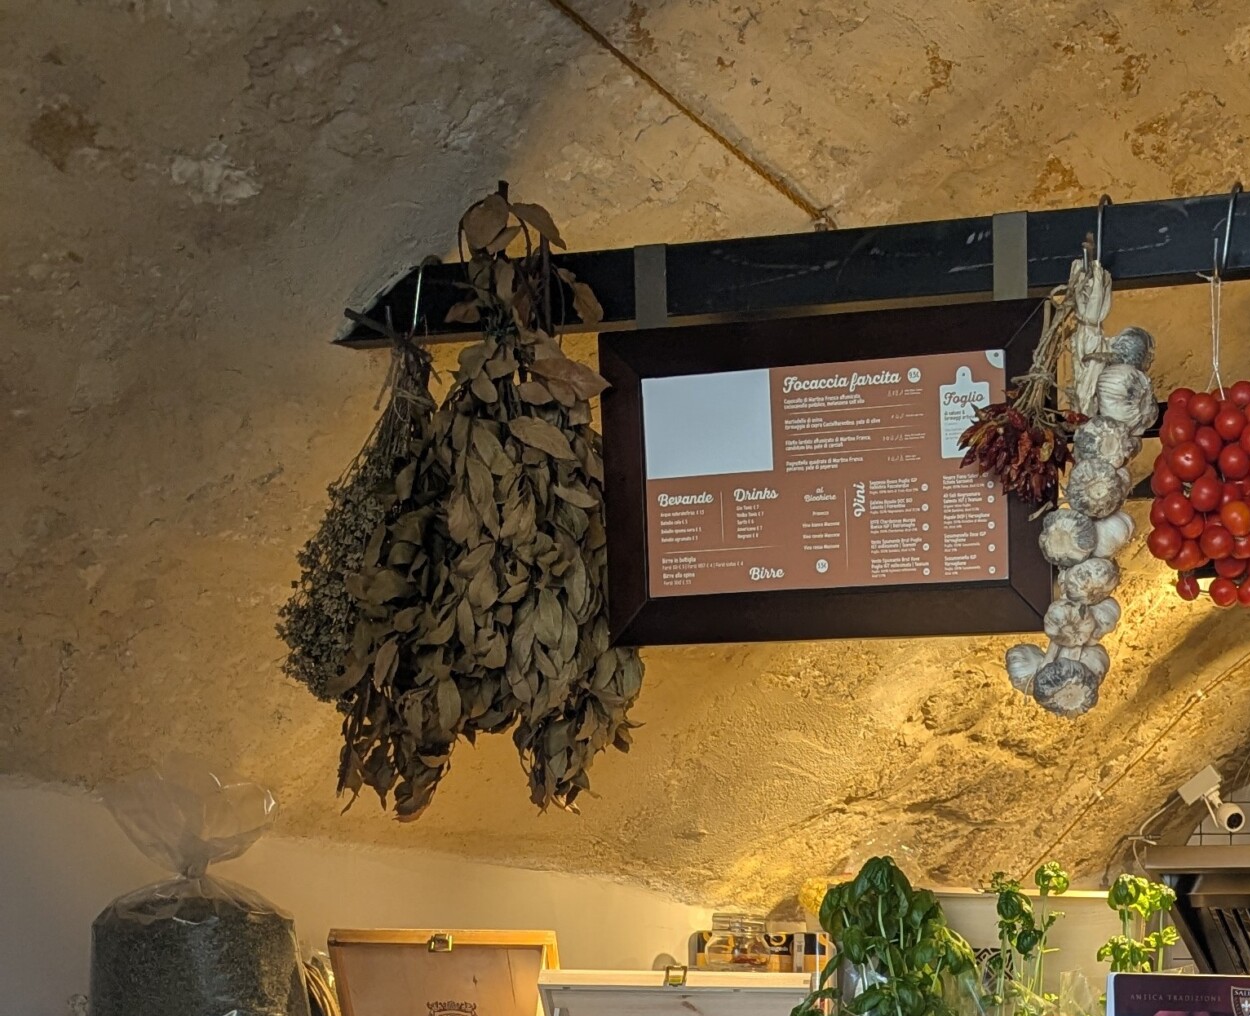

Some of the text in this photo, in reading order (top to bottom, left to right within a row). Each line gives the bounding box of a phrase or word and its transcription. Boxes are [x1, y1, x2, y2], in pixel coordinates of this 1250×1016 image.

[783, 371, 901, 393] Focaccia farcita
[943, 391, 985, 408] Foglio
[657, 491, 714, 507] Bevande
[733, 487, 779, 502] Drinks
[852, 481, 866, 517] Vini
[749, 567, 785, 581] Birre
[1168, 994, 1221, 1002] TRADIZIONE
